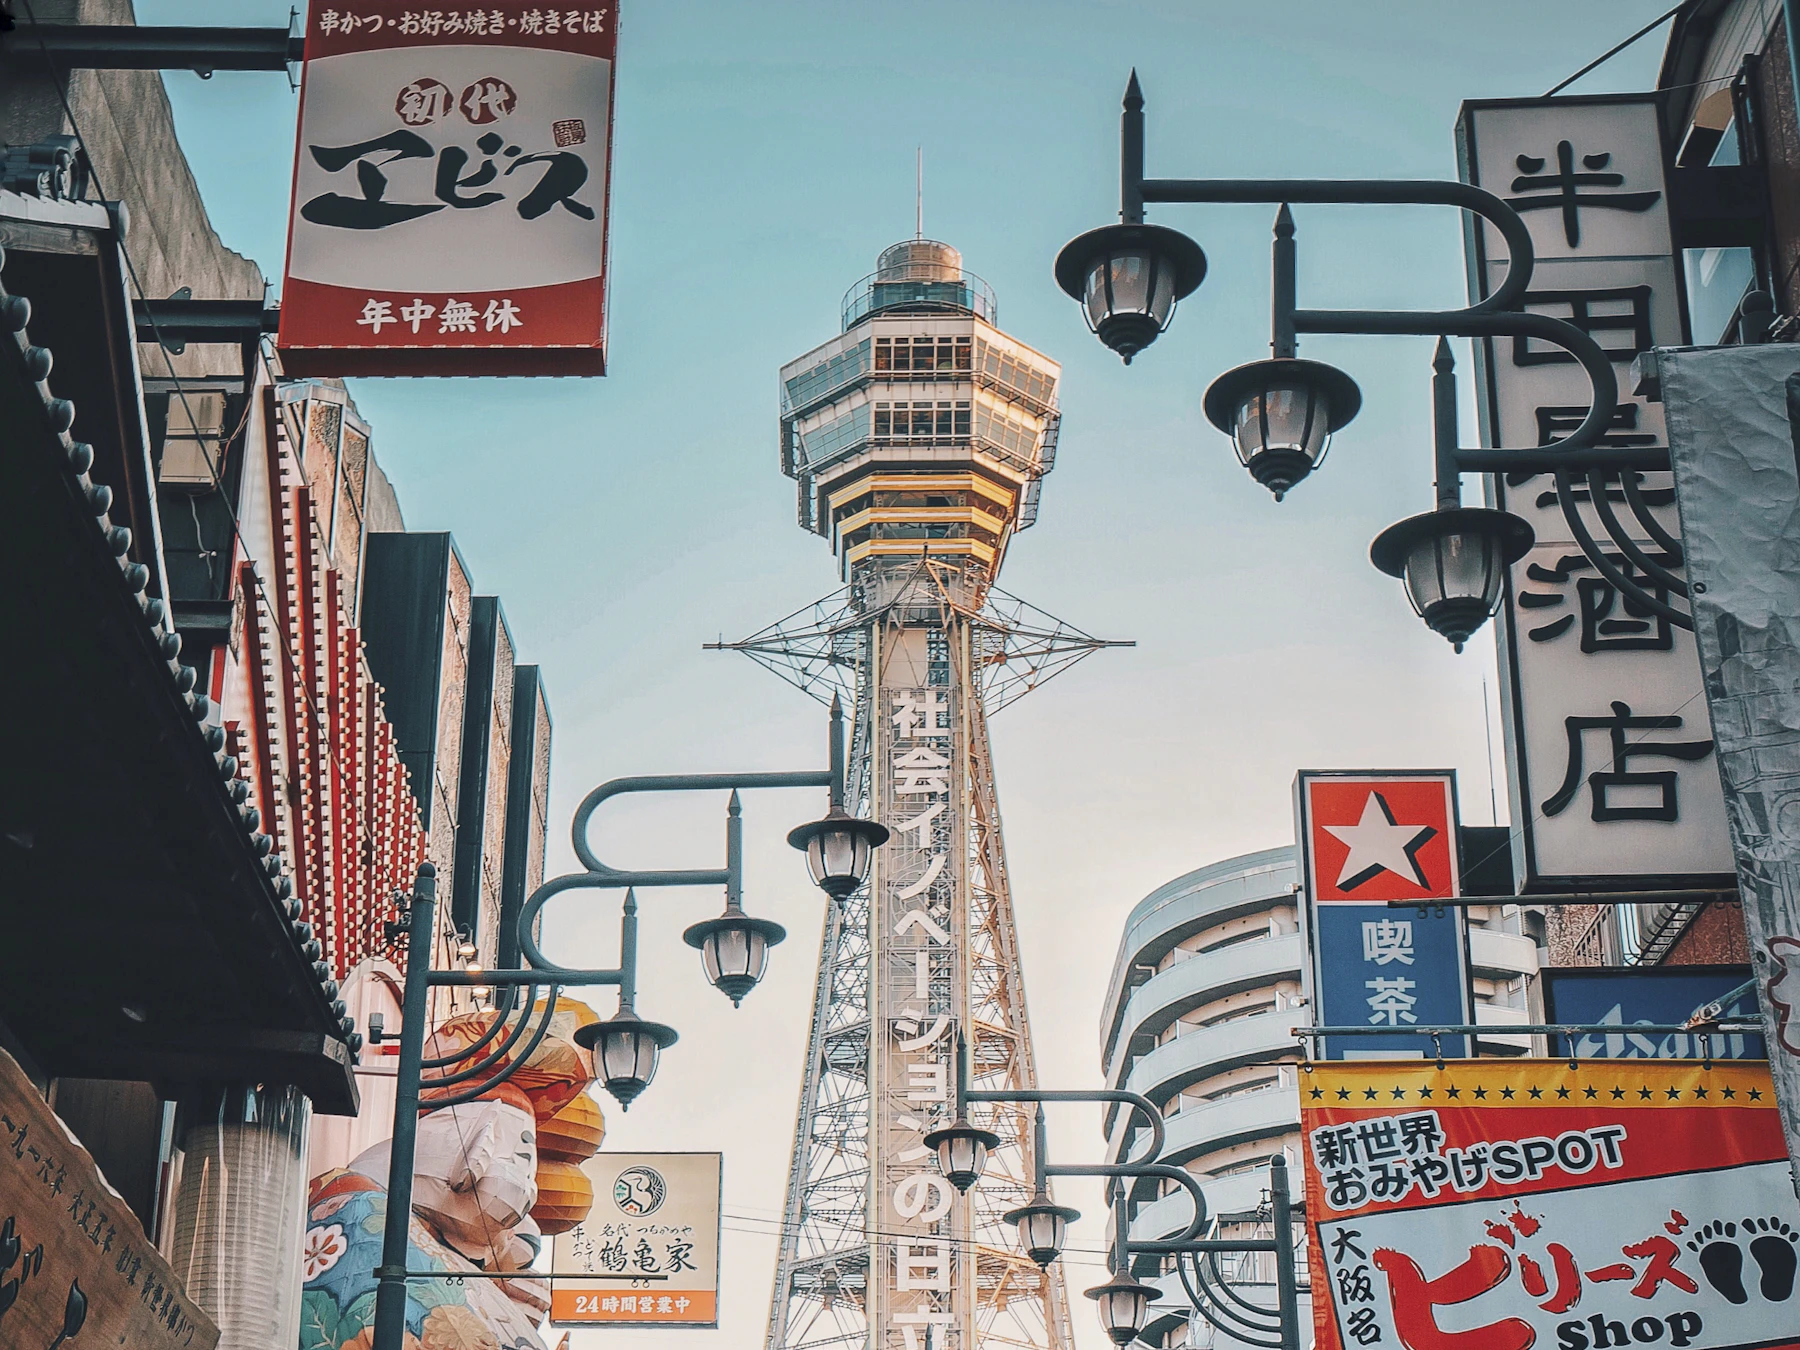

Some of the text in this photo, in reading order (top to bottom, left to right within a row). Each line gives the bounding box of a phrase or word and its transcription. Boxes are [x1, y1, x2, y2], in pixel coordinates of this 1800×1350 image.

[319, 8, 606, 36] 串かつ・お好み焼き・焼きそば
[398, 77, 514, 126] 初代
[300, 129, 596, 229] エビス
[356, 298, 523, 334] 年中無休
[1314, 1114, 1442, 1170] 新世界
[1326, 1128, 1626, 1208] おみやげSPOT
[599, 1236, 698, 1273] 鶴亀家
[576, 1296, 691, 1314] 24時間営業中
